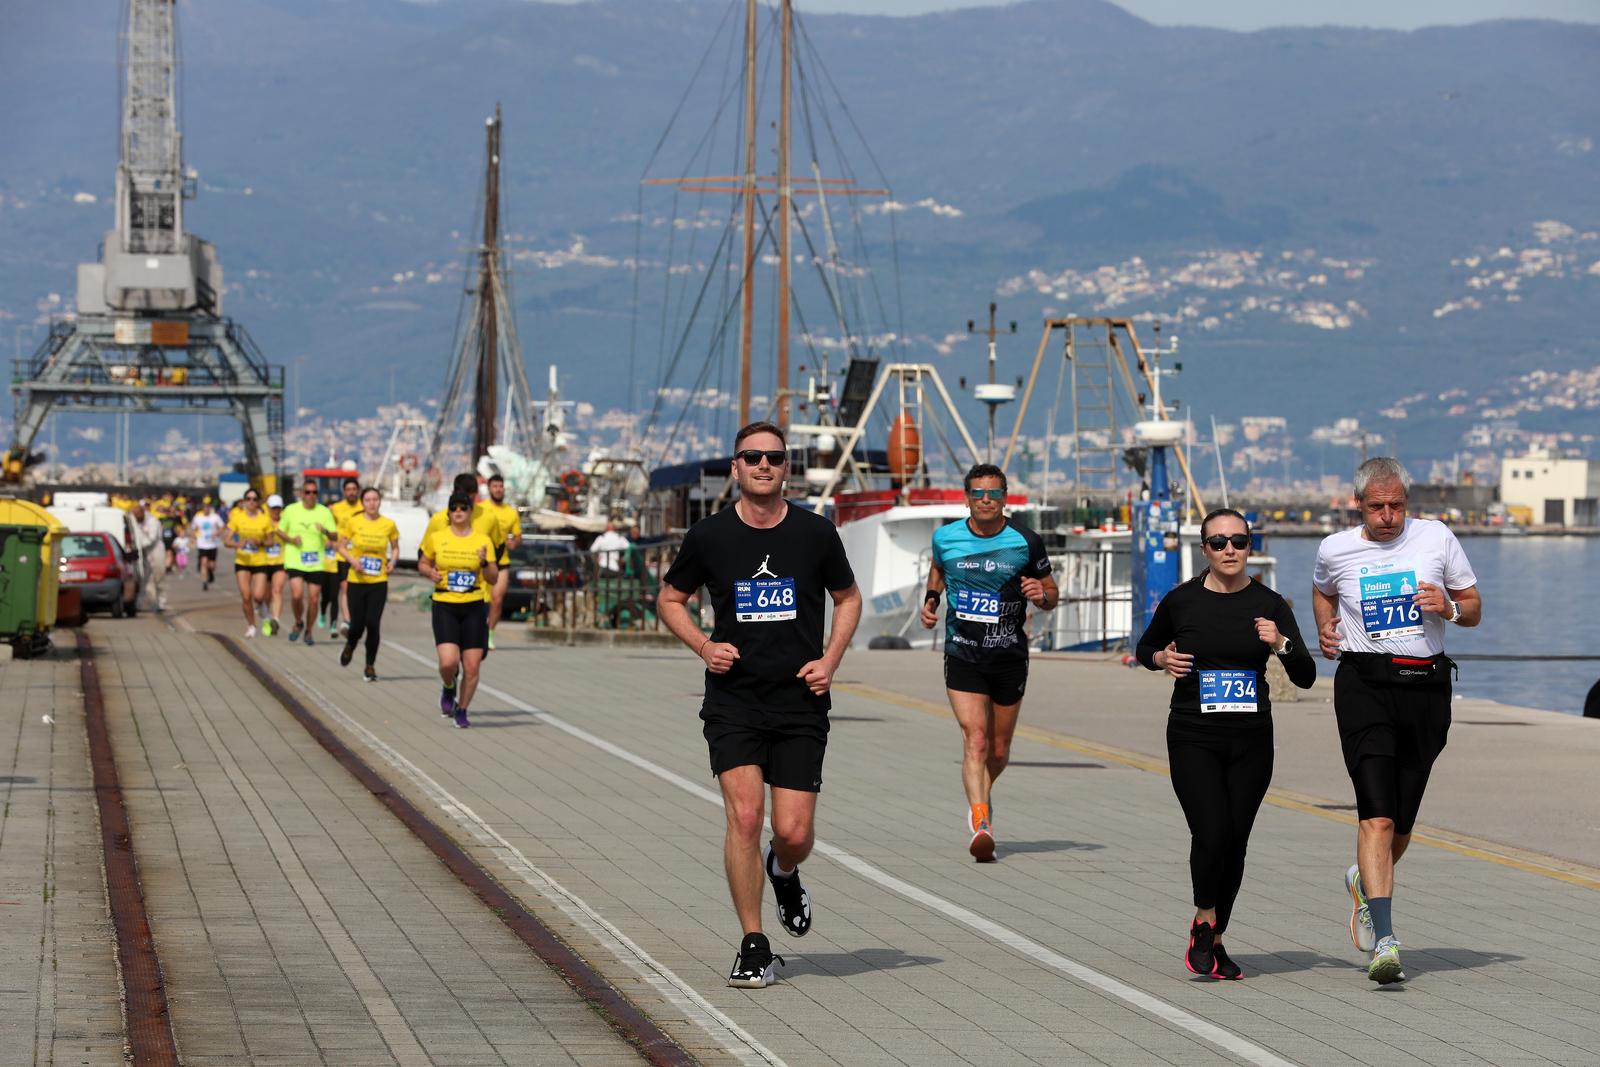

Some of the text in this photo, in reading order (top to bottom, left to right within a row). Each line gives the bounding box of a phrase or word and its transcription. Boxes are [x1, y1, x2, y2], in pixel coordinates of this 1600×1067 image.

[1364, 582, 1391, 591] Volim
[757, 587, 794, 608] 648
[971, 597, 999, 613] 728
[1383, 603, 1420, 625] 716
[1221, 680, 1256, 698] 734
